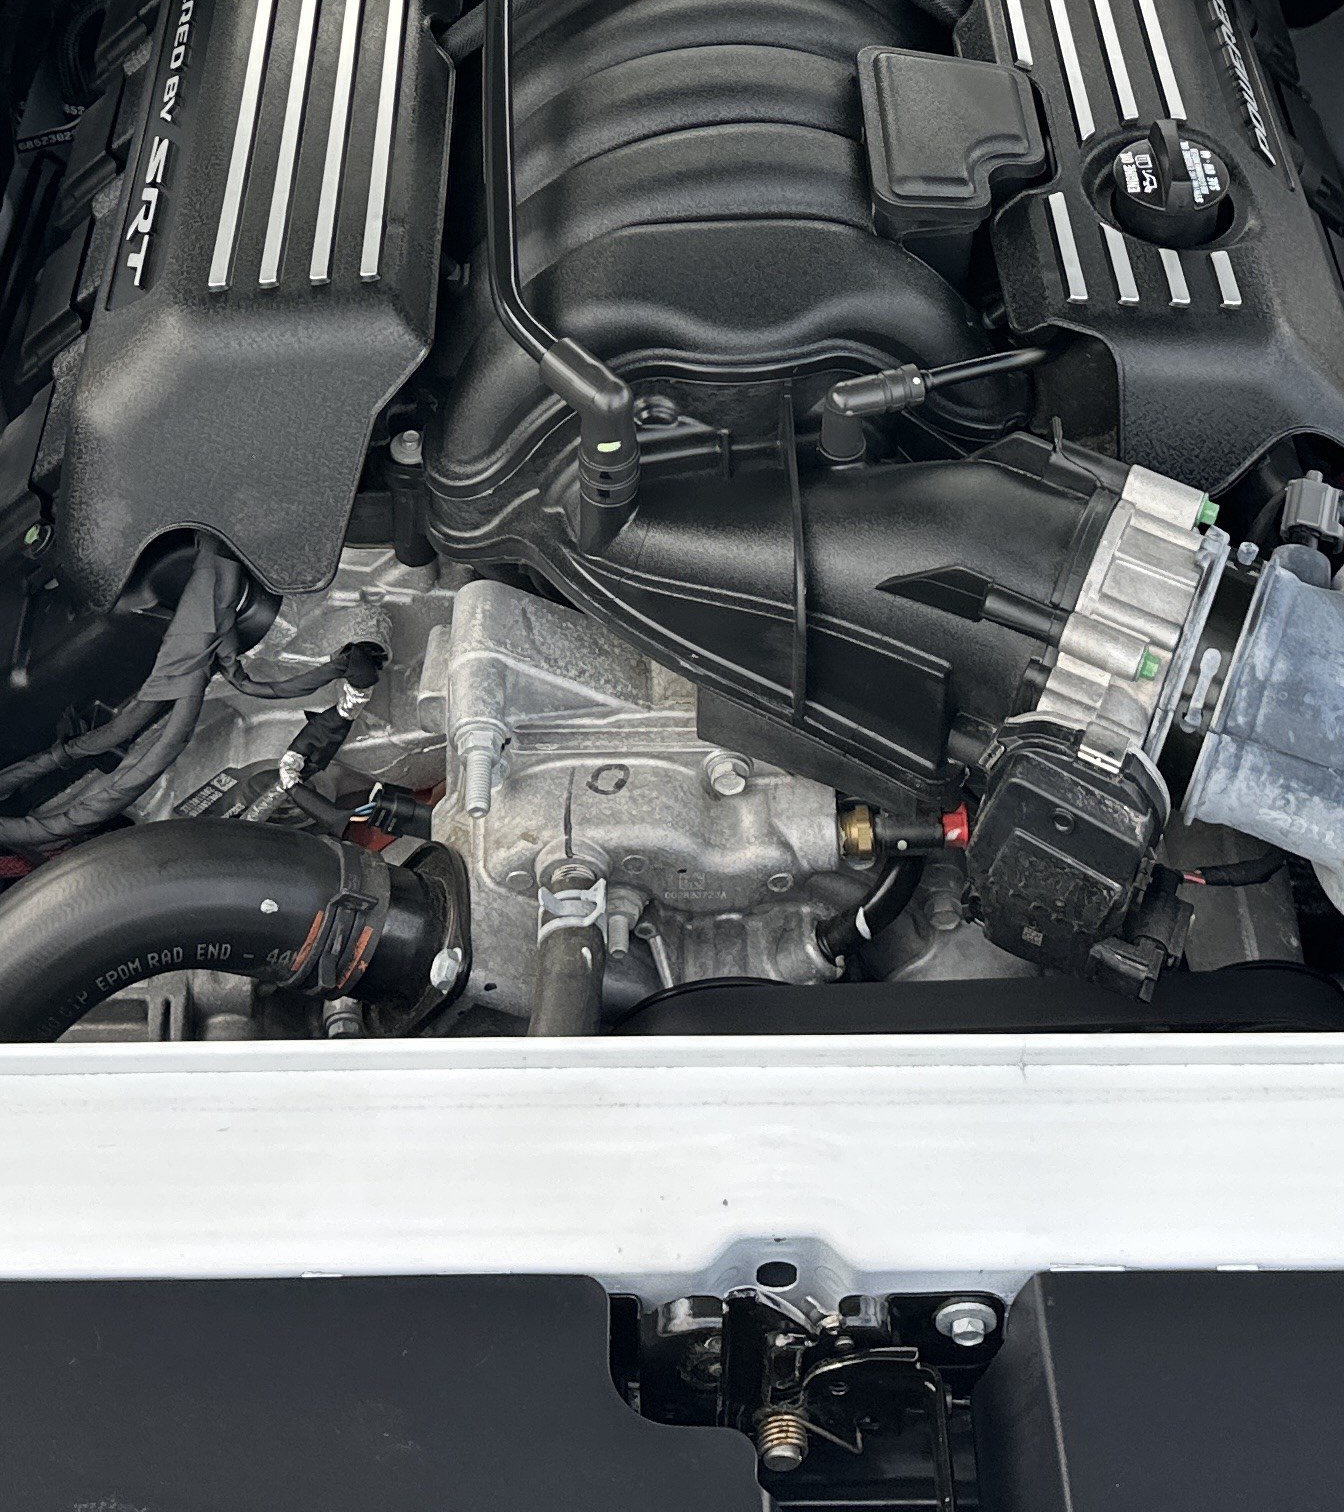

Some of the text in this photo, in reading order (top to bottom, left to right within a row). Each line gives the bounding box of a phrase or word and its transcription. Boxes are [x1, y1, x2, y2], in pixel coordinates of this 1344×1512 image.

[159, 75, 180, 123] BY
[125, 135, 170, 287] SRT
[94, 957, 144, 991] EPDM
[146, 946, 184, 968] RAD
[195, 943, 232, 961] END
